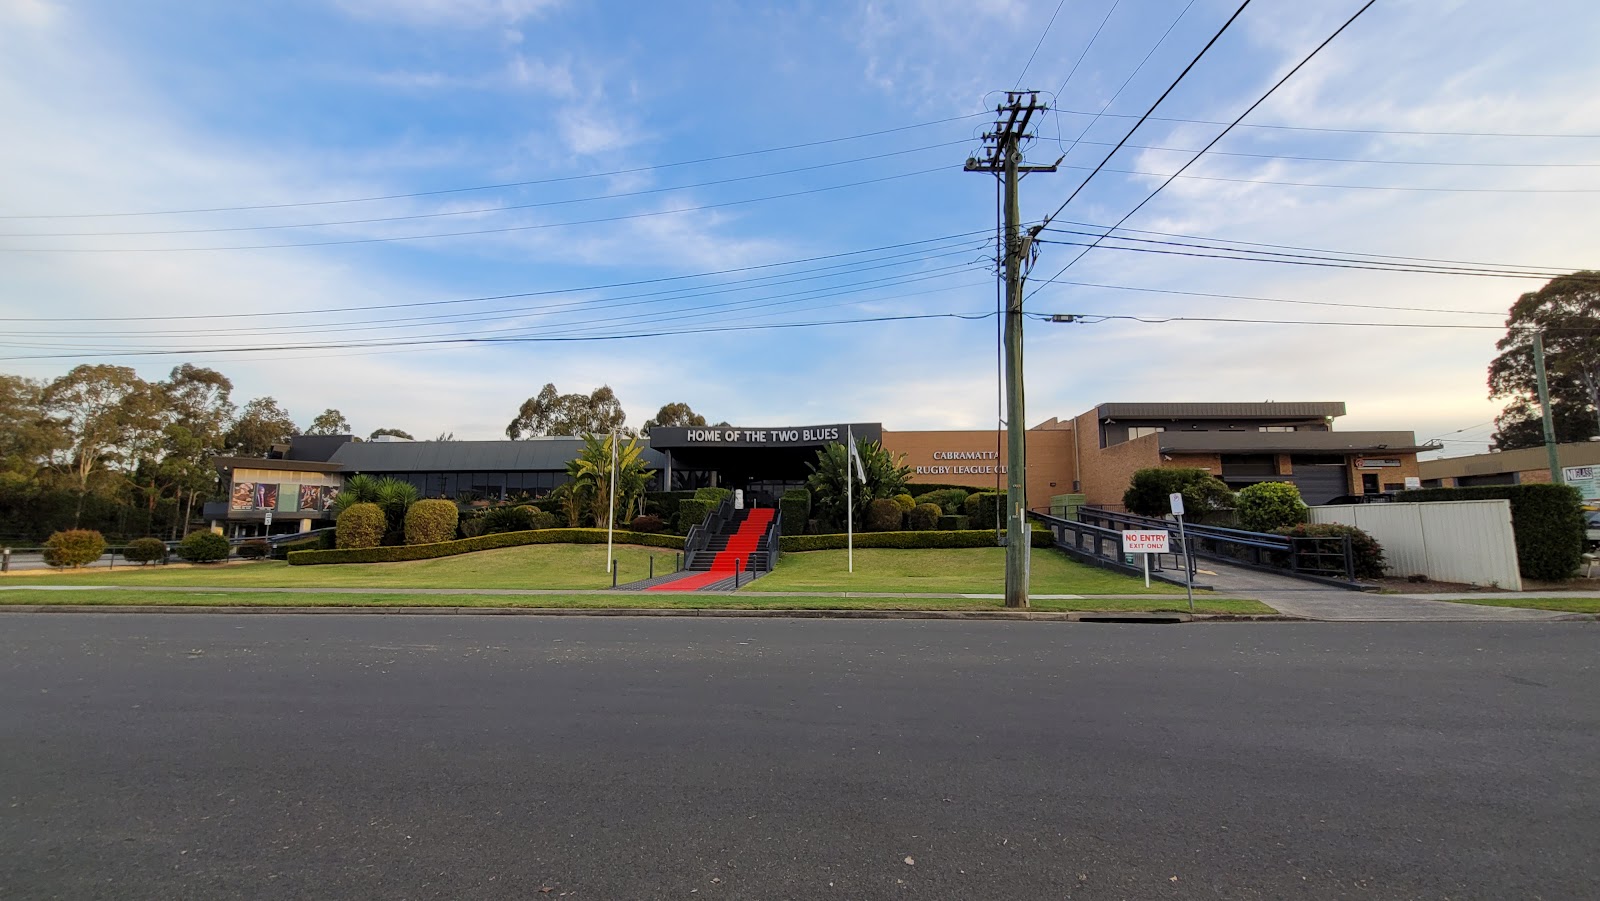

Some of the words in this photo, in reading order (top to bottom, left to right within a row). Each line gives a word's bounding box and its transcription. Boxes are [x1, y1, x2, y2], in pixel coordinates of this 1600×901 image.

[687, 430, 721, 442] HOME
[724, 430, 741, 442] OF
[744, 430, 767, 442] THE
[771, 430, 799, 442] TWO
[803, 428, 838, 441] BLUES
[933, 451, 998, 460] CABRAMATTA
[916, 465, 950, 474] RUGBY
[953, 465, 991, 474] LEAGUE
